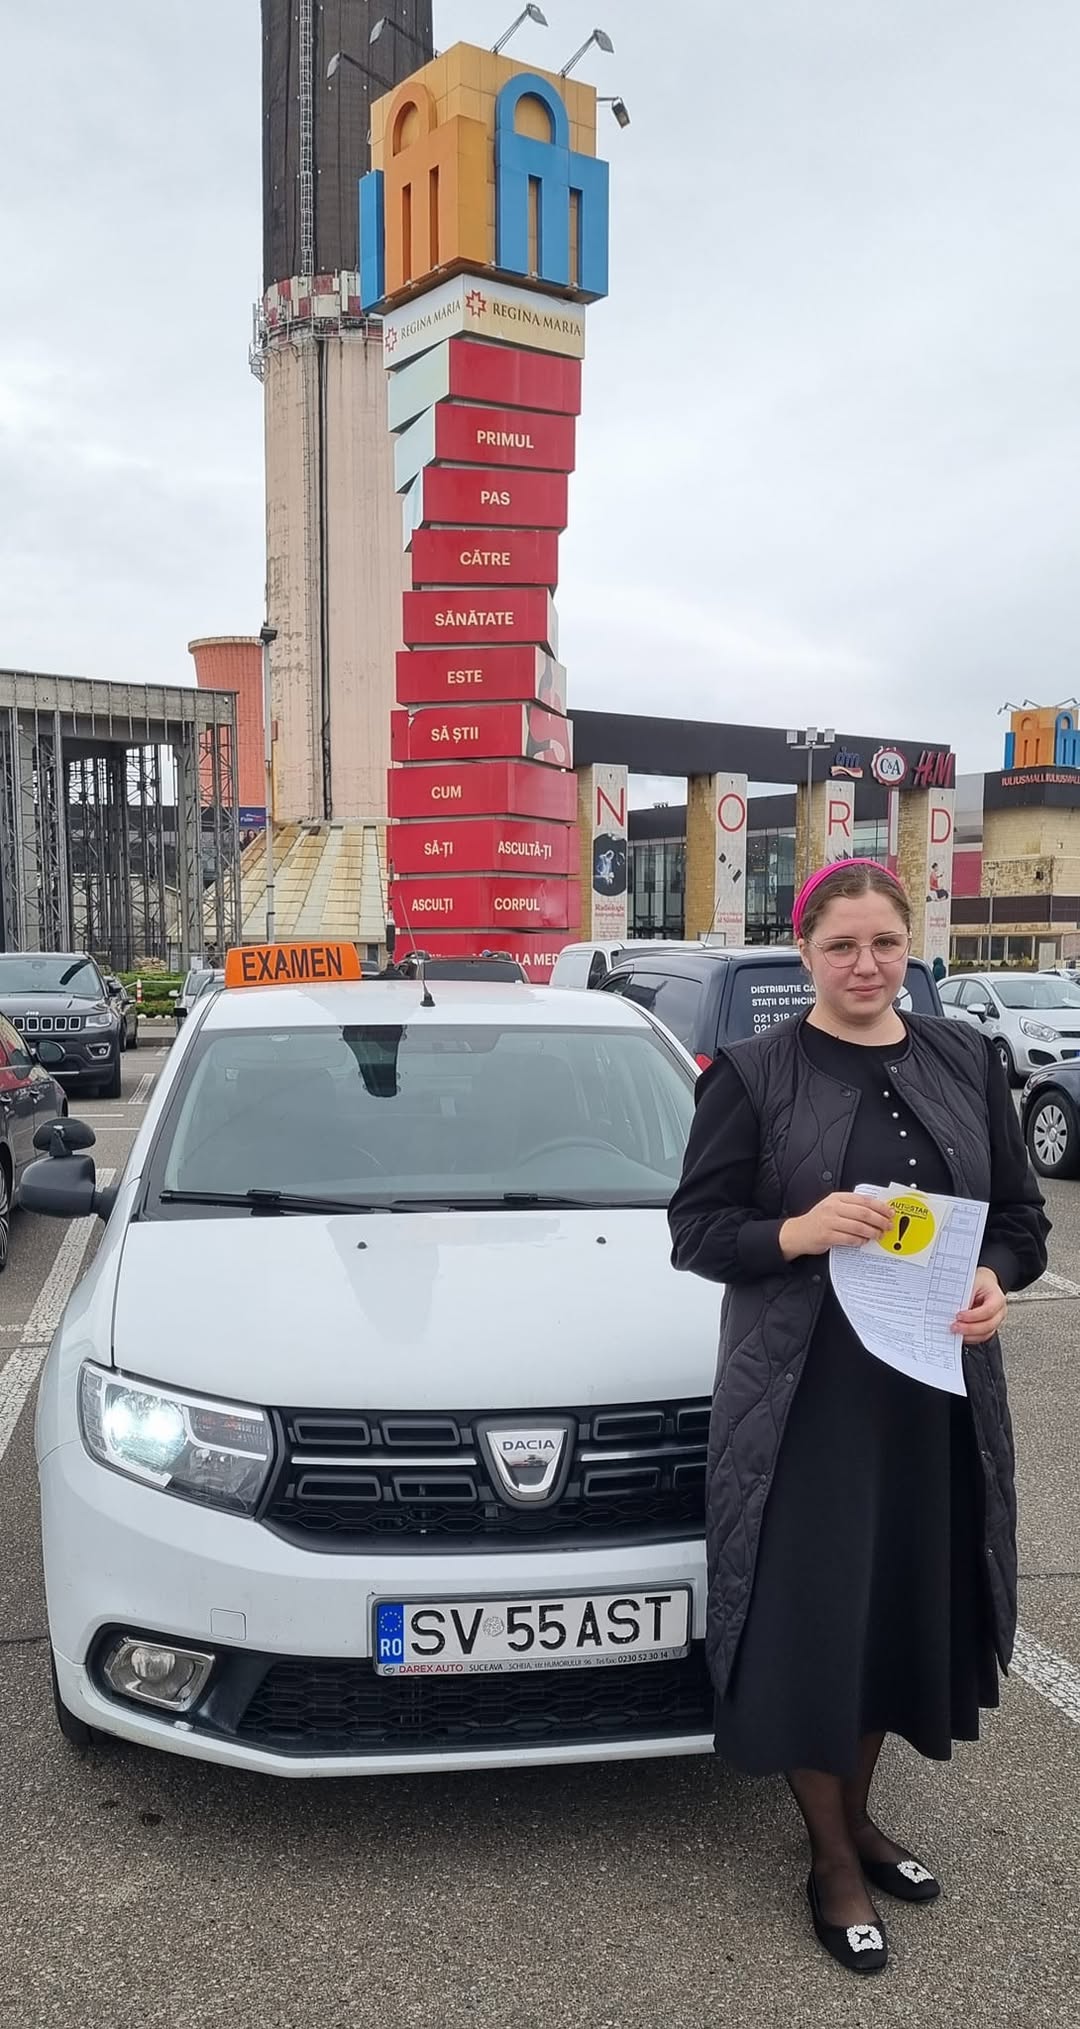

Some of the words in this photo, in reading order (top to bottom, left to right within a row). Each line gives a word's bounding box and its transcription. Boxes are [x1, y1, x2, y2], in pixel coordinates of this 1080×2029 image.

[401, 315, 432, 340] REGINA
[433, 300, 461, 323] MARIA
[492, 303, 540, 326] REGINA
[543, 316, 581, 336] MARIA
[477, 430, 534, 449] PRIMUL
[480, 491, 511, 505] PAS
[460, 549, 511, 566] CĂTRE
[434, 610, 514, 626] SĂNĂTATE
[447, 670, 483, 684] ESTE
[431, 725, 450, 741] SĂ
[452, 726, 479, 744] ȘTII
[880, 758, 901, 776] C&A
[913, 750, 956, 788] H&M
[431, 785, 462, 799] CUM
[597, 786, 625, 827] N
[718, 793, 746, 832] O
[828, 800, 851, 837] R
[931, 808, 952, 843] D
[424, 839, 453, 858] SĂ-ȚI
[498, 840, 552, 860] ASCULTĂ-ȚI
[412, 898, 453, 914] ASCULȚI
[494, 897, 540, 911] CORPUL
[241, 947, 343, 982] EXAMEN
[751, 984, 801, 994] DISTRIBUȚIE
[752, 998, 777, 1008] STAȚII
[779, 997, 790, 1006] DE
[753, 1013, 771, 1023] 021
[502, 1439, 555, 1450] DACIA
[411, 1608, 484, 1656] SV
[506, 1604, 567, 1652] 55
[576, 1595, 671, 1648] AST
[380, 1638, 402, 1657] RO
[399, 1664, 433, 1673] DAREX
[434, 1664, 464, 1673] AUTO
[469, 1663, 503, 1672] SUCEAVA
[618, 1655, 637, 1663] 0230
[638, 1653, 647, 1661] 52
[648, 1652, 659, 1660] 30
